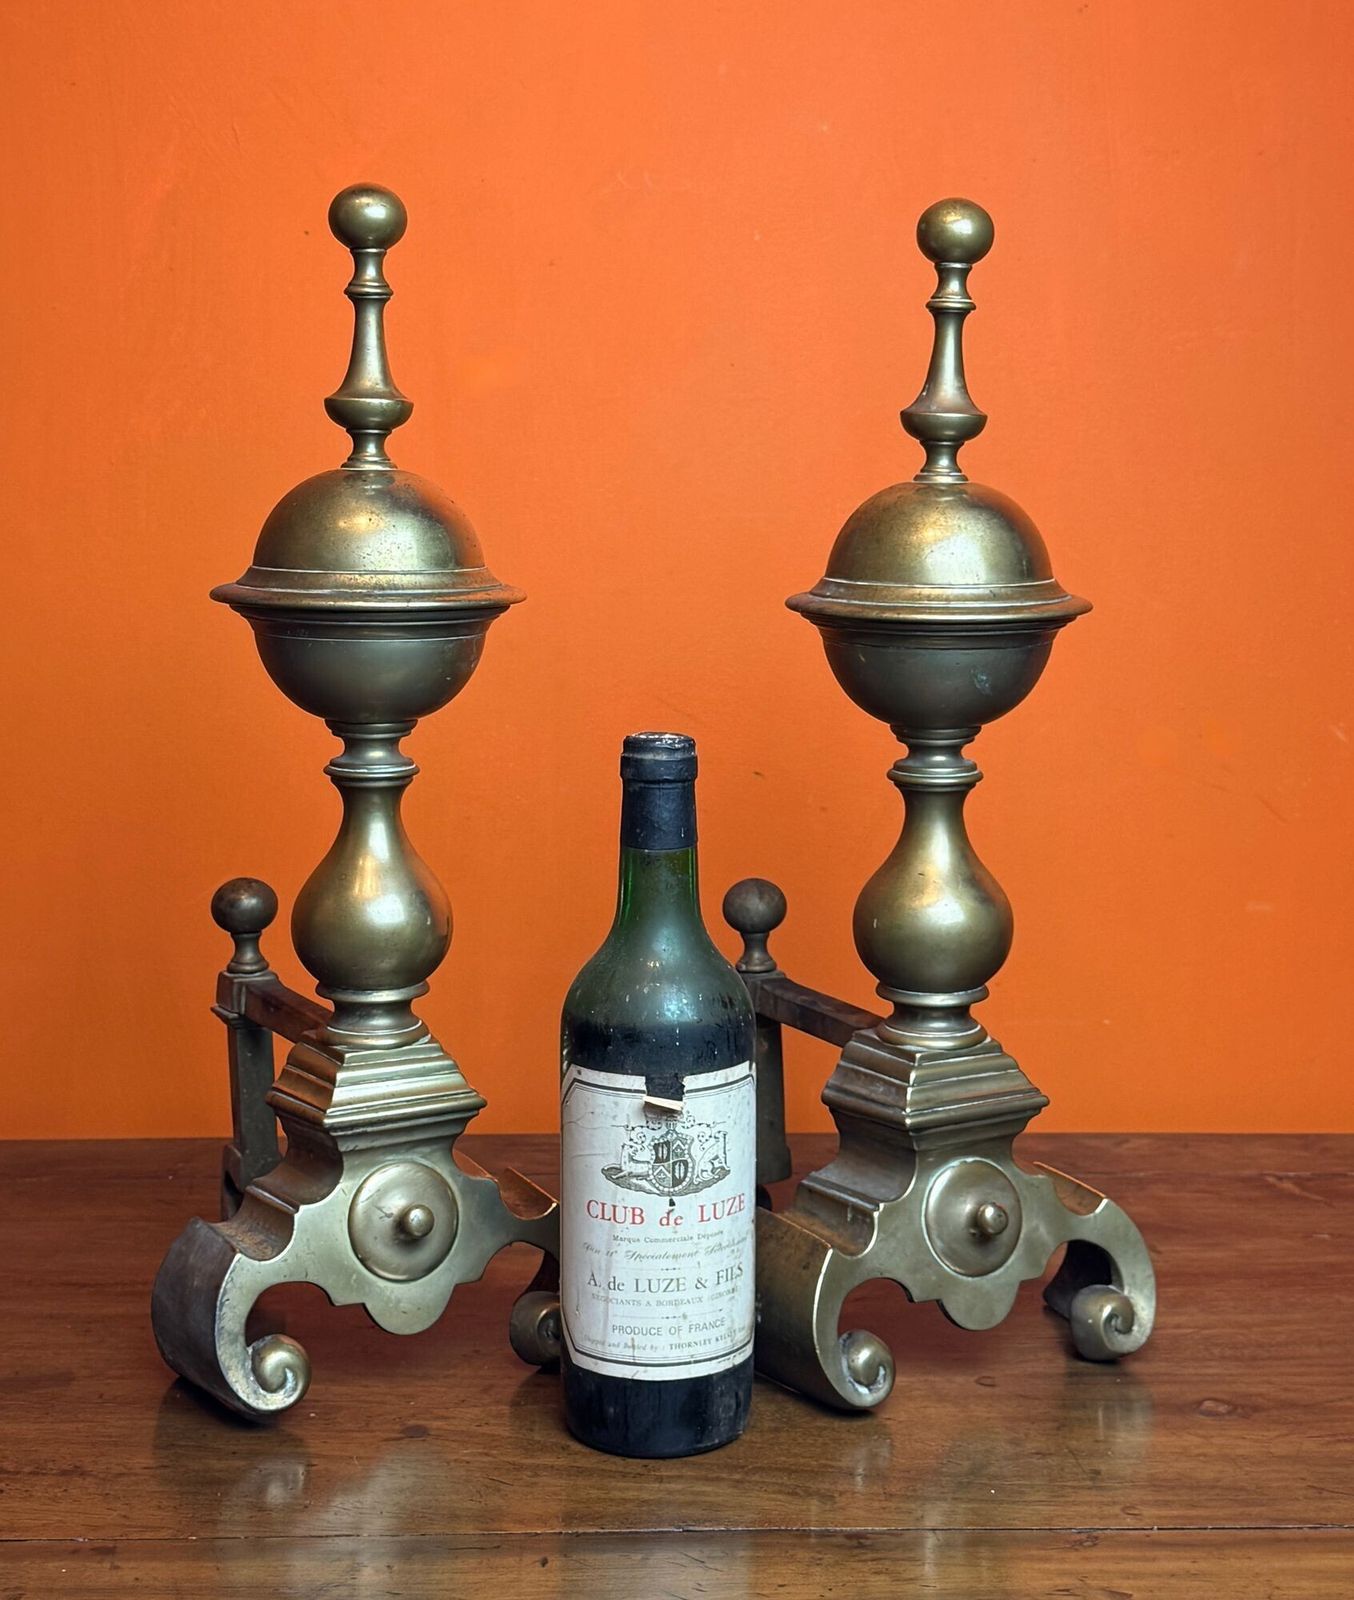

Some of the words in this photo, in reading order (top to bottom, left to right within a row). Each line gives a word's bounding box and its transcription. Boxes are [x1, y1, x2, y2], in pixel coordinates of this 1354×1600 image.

[587, 1199, 645, 1225] CLUB
[659, 1208, 683, 1227] de
[698, 1193, 746, 1223] LUZE
[612, 1234, 640, 1244] Marque
[643, 1235, 694, 1244] Commerciale
[587, 1270, 602, 1288] A.
[607, 1275, 625, 1292] de
[634, 1277, 687, 1294] LUZE
[695, 1277, 709, 1290] &
[715, 1262, 744, 1286] FILS
[655, 1296, 704, 1307] BORDEAUX
[612, 1324, 663, 1337] PRODUCE
[668, 1326, 683, 1337] OF
[688, 1316, 726, 1334] FRANCE
